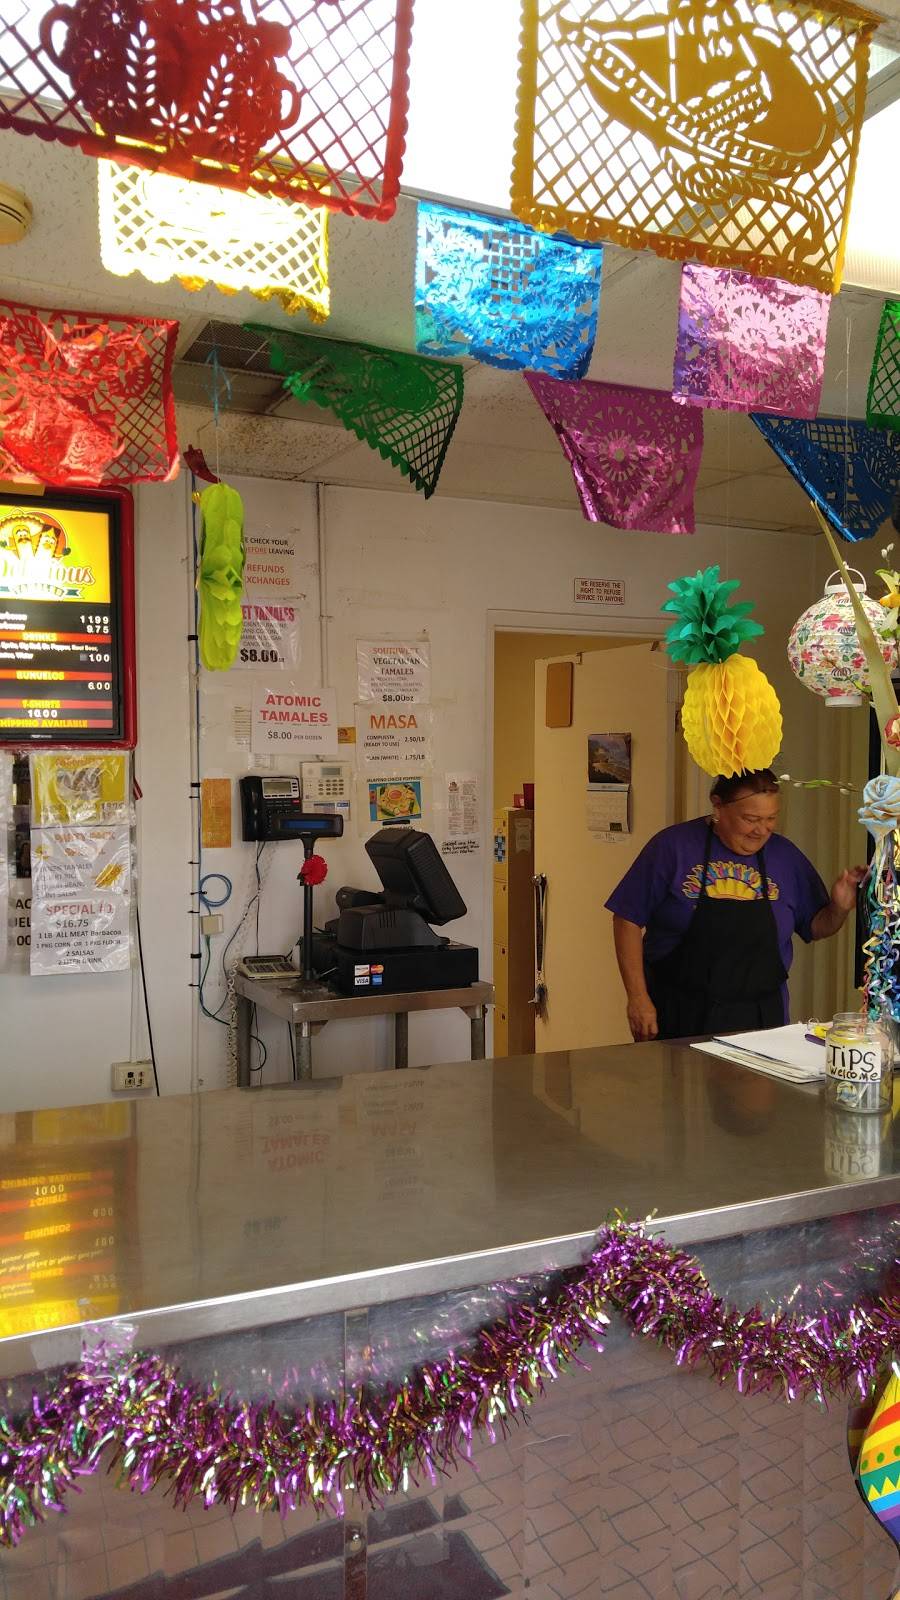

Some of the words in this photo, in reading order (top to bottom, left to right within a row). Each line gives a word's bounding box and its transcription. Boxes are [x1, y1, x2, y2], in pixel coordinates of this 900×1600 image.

[268, 548, 295, 556] LEAVING
[247, 564, 285, 573] REFUNDS
[246, 576, 290, 586] XCHANGES
[266, 695, 321, 707] ATOMIC
[260, 710, 328, 723] TAMALES
[370, 714, 418, 729] MASA
[267, 730, 292, 740] $8.00
[47, 904, 96, 916] SPECIAL
[56, 919, 89, 928] $16.75
